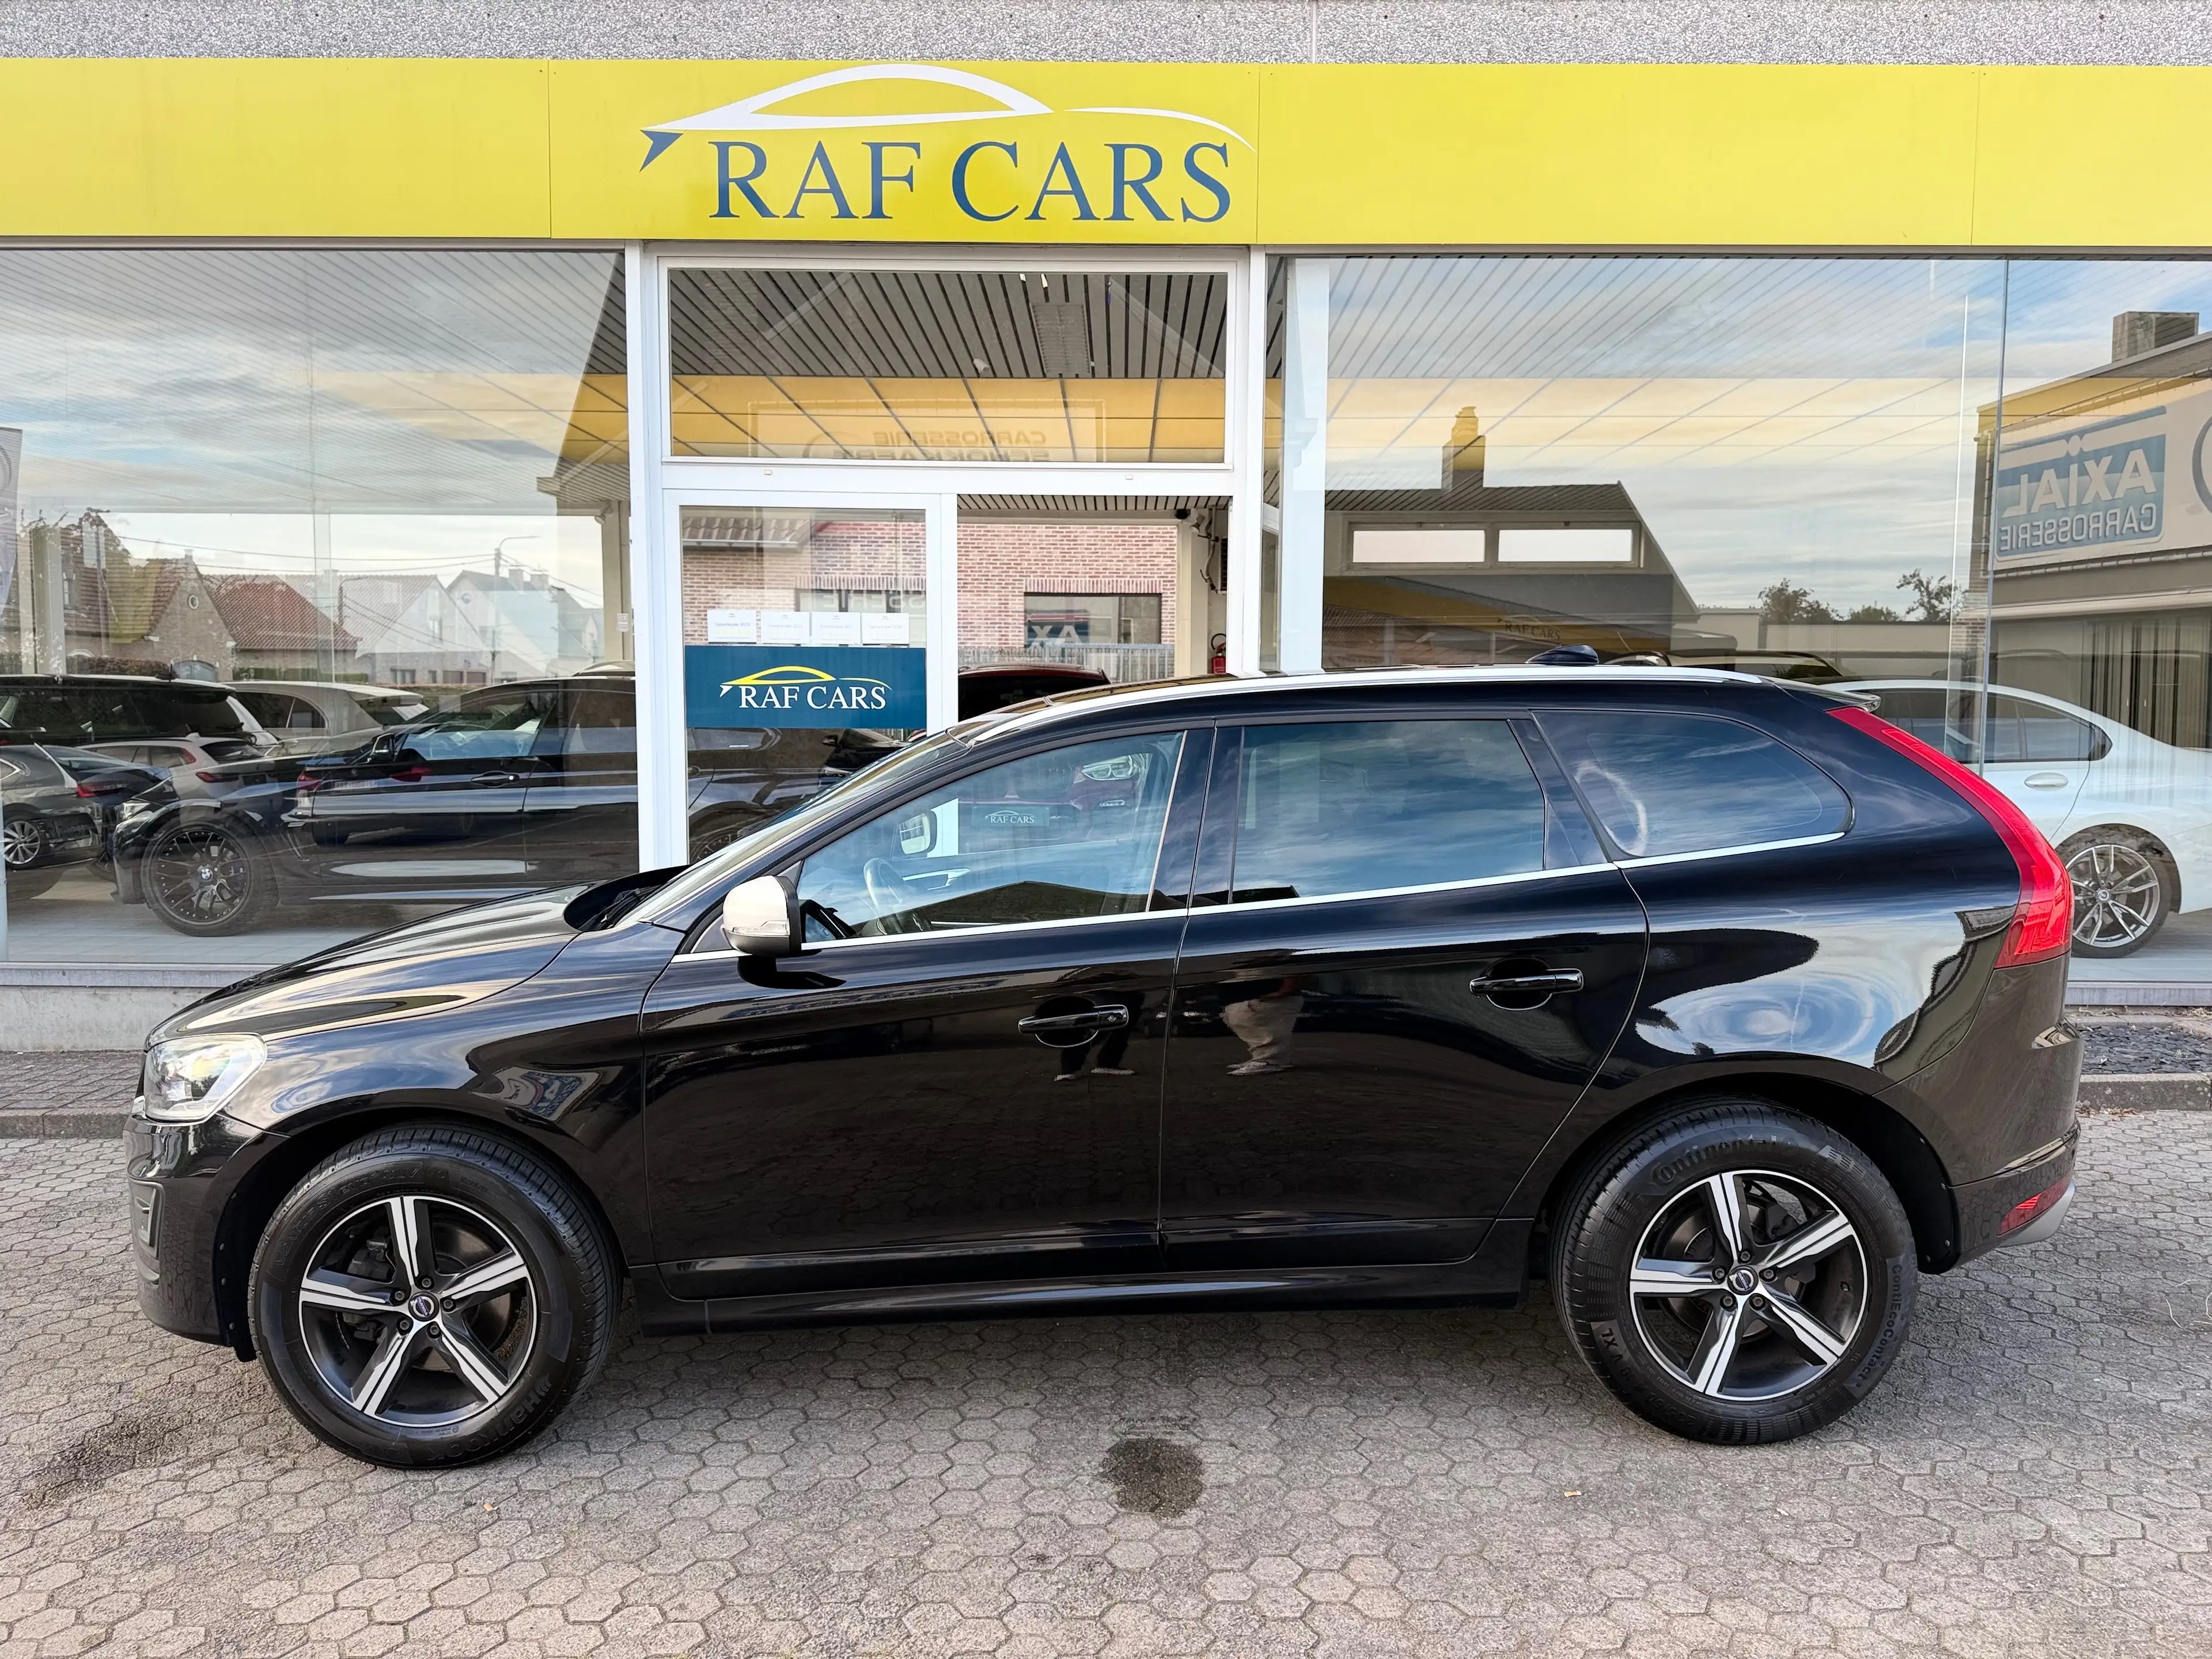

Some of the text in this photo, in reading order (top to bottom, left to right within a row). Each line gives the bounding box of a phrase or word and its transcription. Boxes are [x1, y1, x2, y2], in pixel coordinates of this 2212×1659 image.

[707, 140, 1232, 224] RAF CARS
[1531, 625, 1560, 641] CARS
[738, 685, 887, 710] RAF CARS
[990, 816, 1035, 824] RAF CARS
[1651, 1134, 1778, 1187] Continental
[1858, 1264, 1903, 1380] ContiEcoContact
[1601, 1327, 1619, 1350] XL
